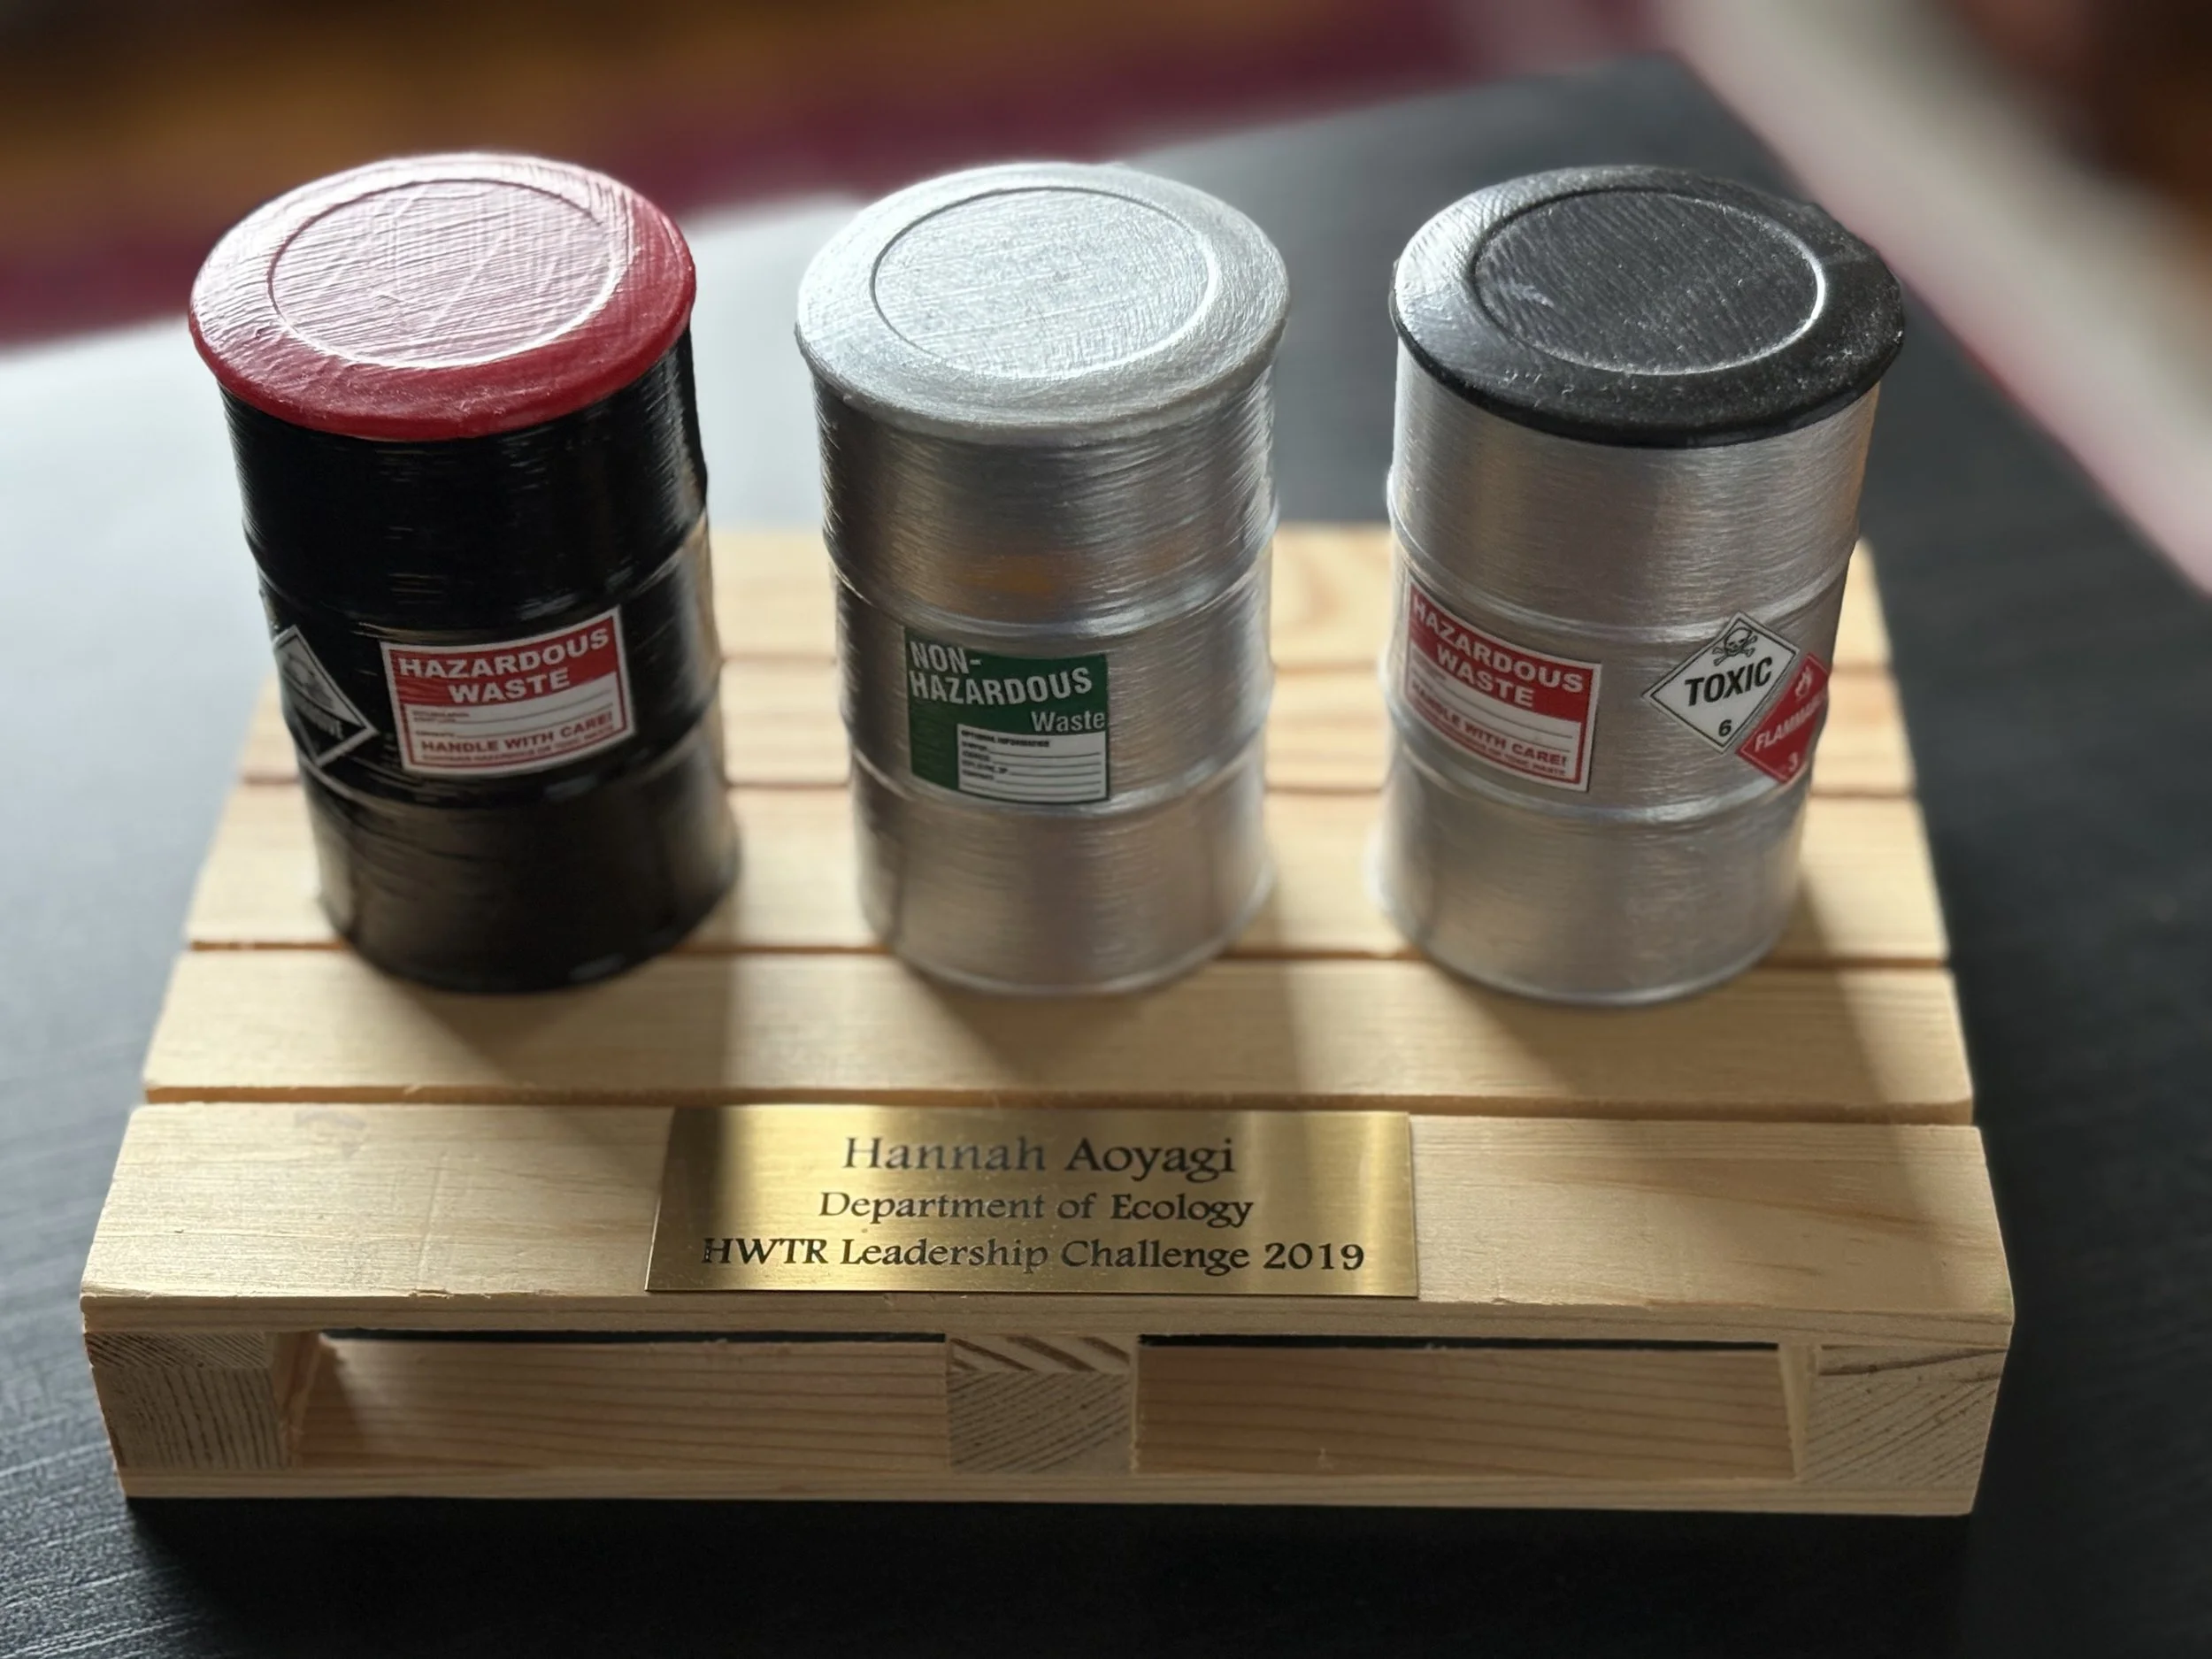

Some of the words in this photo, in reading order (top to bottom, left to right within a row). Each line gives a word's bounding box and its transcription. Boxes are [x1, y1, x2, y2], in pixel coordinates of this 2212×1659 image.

[399, 627, 609, 678] HAZARDOUS
[910, 641, 981, 673] NON-
[1414, 594, 1584, 693] HAZARDOUS
[449, 668, 570, 703] WASTE
[910, 667, 1092, 705] HAZARDOUS
[1437, 644, 1534, 707] WASTE
[1685, 657, 1772, 706] TOXIC
[420, 739, 498, 752] HANDLE
[503, 733, 554, 749] WITH
[560, 710, 613, 738] CARE!
[1032, 710, 1104, 732] Waste
[1718, 719, 1732, 737] 6
[1464, 722, 1506, 749] WITH
[1511, 741, 1567, 766] CARE!
[843, 1135, 1046, 1171] Hannah
[1064, 1137, 1236, 1183] Aoyagi
[818, 1191, 1044, 1225] Department
[1056, 1193, 1097, 1220] of
[1110, 1193, 1254, 1228] Ecology
[701, 1238, 828, 1265] HWTR
[840, 1238, 1048, 1275] Leadership
[1060, 1239, 1250, 1277] Challenge
[1263, 1241, 1364, 1271] 2019
